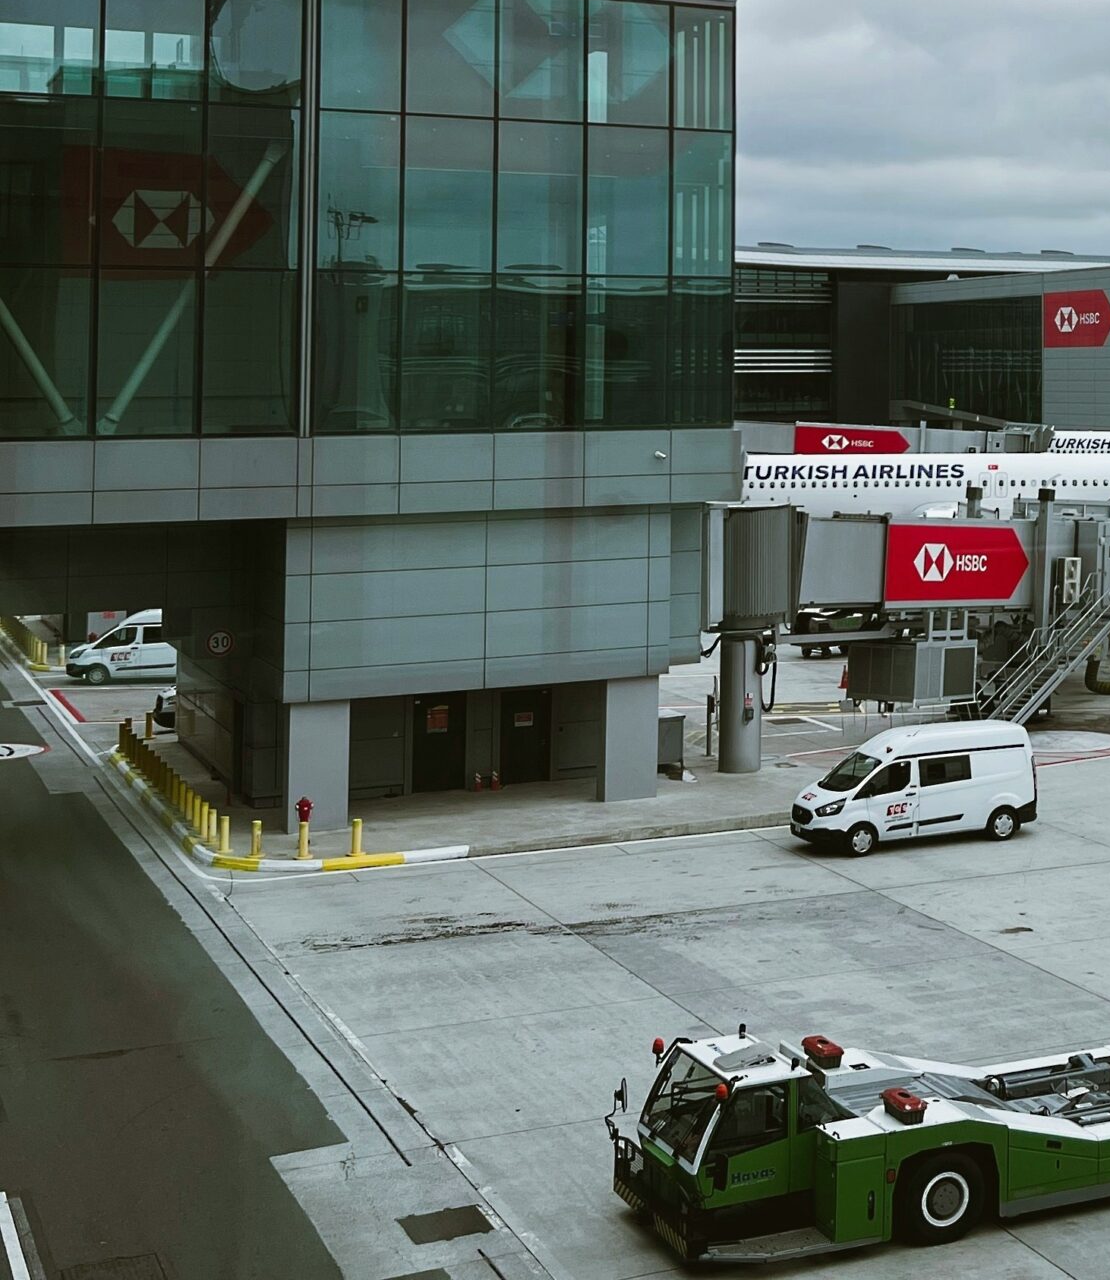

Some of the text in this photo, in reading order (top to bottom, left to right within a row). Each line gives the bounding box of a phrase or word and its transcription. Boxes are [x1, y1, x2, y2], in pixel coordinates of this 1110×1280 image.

[1079, 312, 1101, 325] HSBC
[850, 439, 875, 448] HSBC
[743, 464, 965, 480] TURKISH AIRLINES
[956, 554, 988, 572] HSBC
[212, 635, 229, 649] 30
